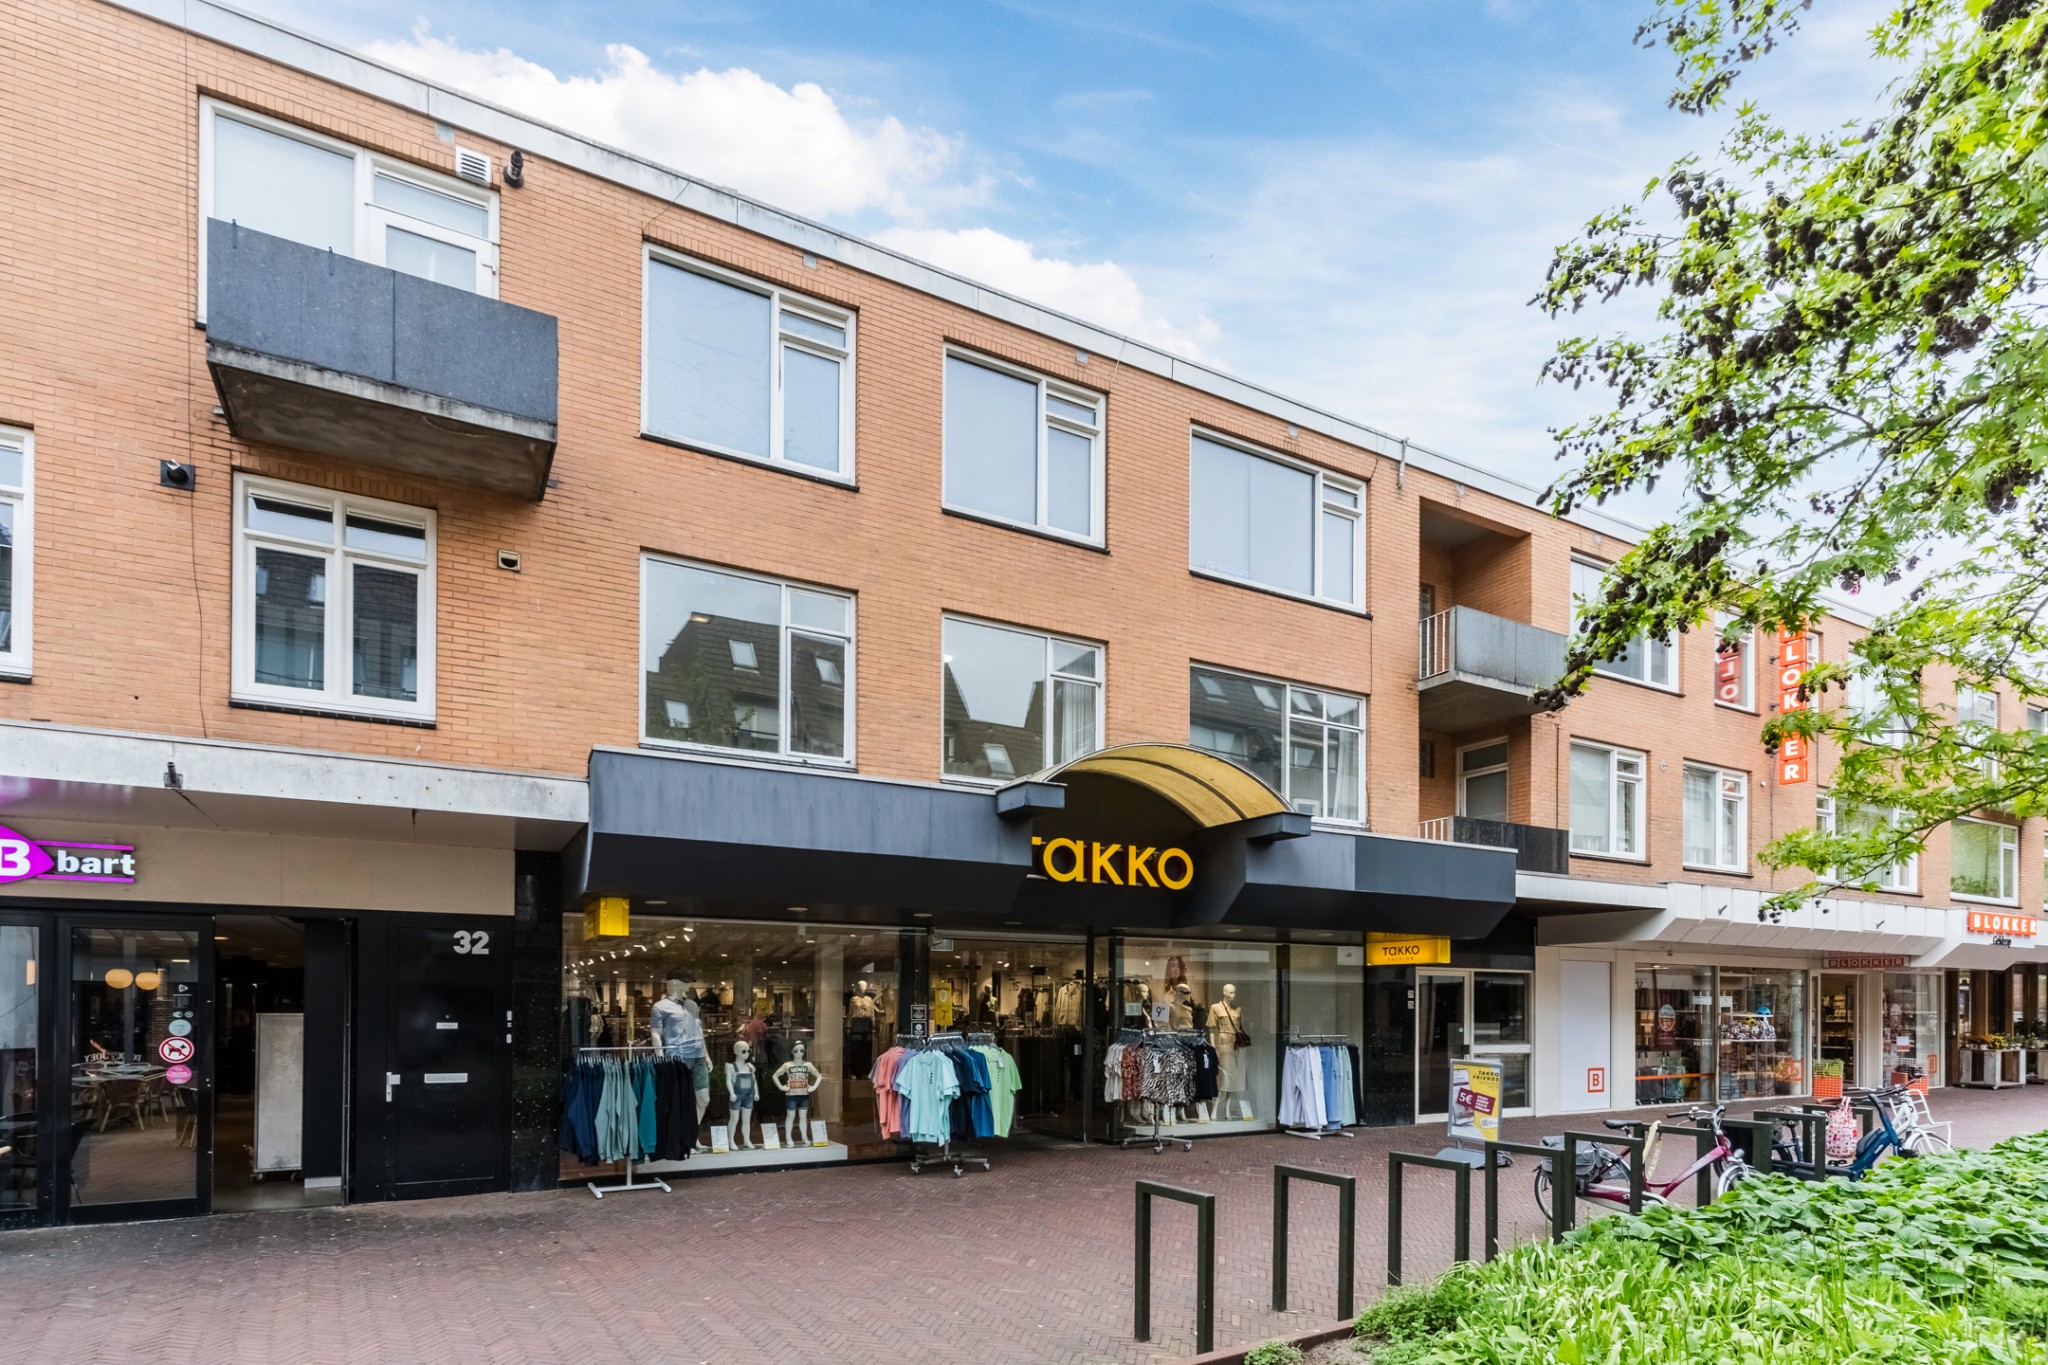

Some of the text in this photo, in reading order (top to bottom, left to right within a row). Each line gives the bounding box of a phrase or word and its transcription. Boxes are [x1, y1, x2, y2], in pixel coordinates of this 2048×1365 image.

[1781, 622, 1801, 780] LOKER
[57, 849, 136, 876] bart
[1973, 914, 2037, 933] BLOKKER
[453, 930, 490, 955] 32
[1830, 958, 1903, 967] BLOKKER
[1592, 1073, 1600, 1087] B
[1459, 1091, 1473, 1105] 5€
